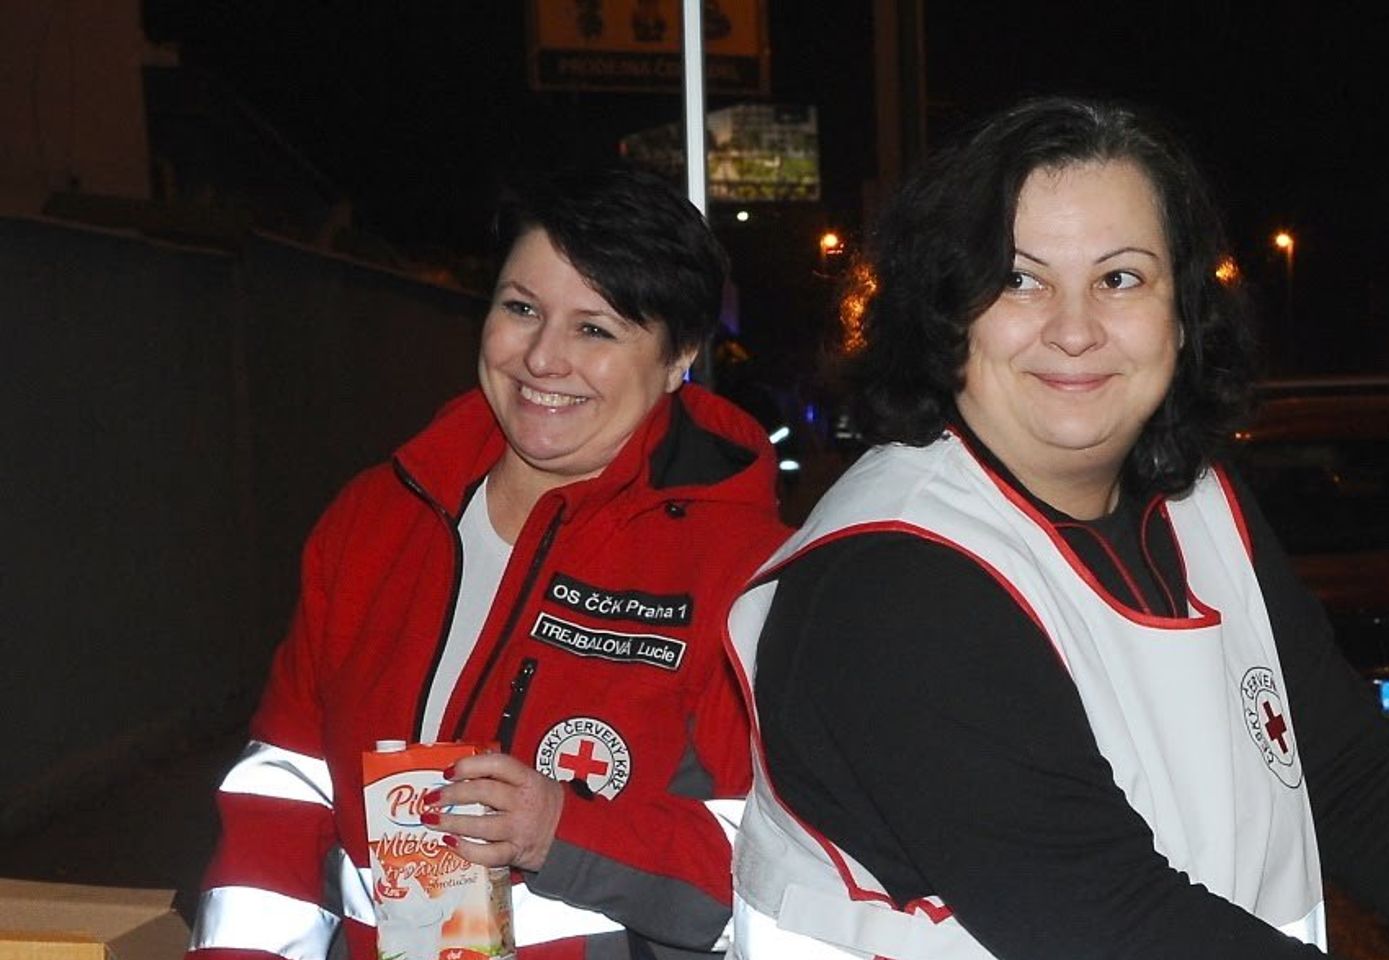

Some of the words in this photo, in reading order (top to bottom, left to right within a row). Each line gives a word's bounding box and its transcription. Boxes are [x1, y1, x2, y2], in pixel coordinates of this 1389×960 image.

[553, 584, 581, 604] OS
[585, 592, 623, 614] ČČK
[626, 599, 673, 619] Praha
[678, 604, 687, 619] 1
[541, 620, 631, 656] TREJBALOVÁ
[637, 642, 675, 662] Lucie
[564, 719, 628, 755] ČERVENÝ
[386, 784, 441, 818] Pil
